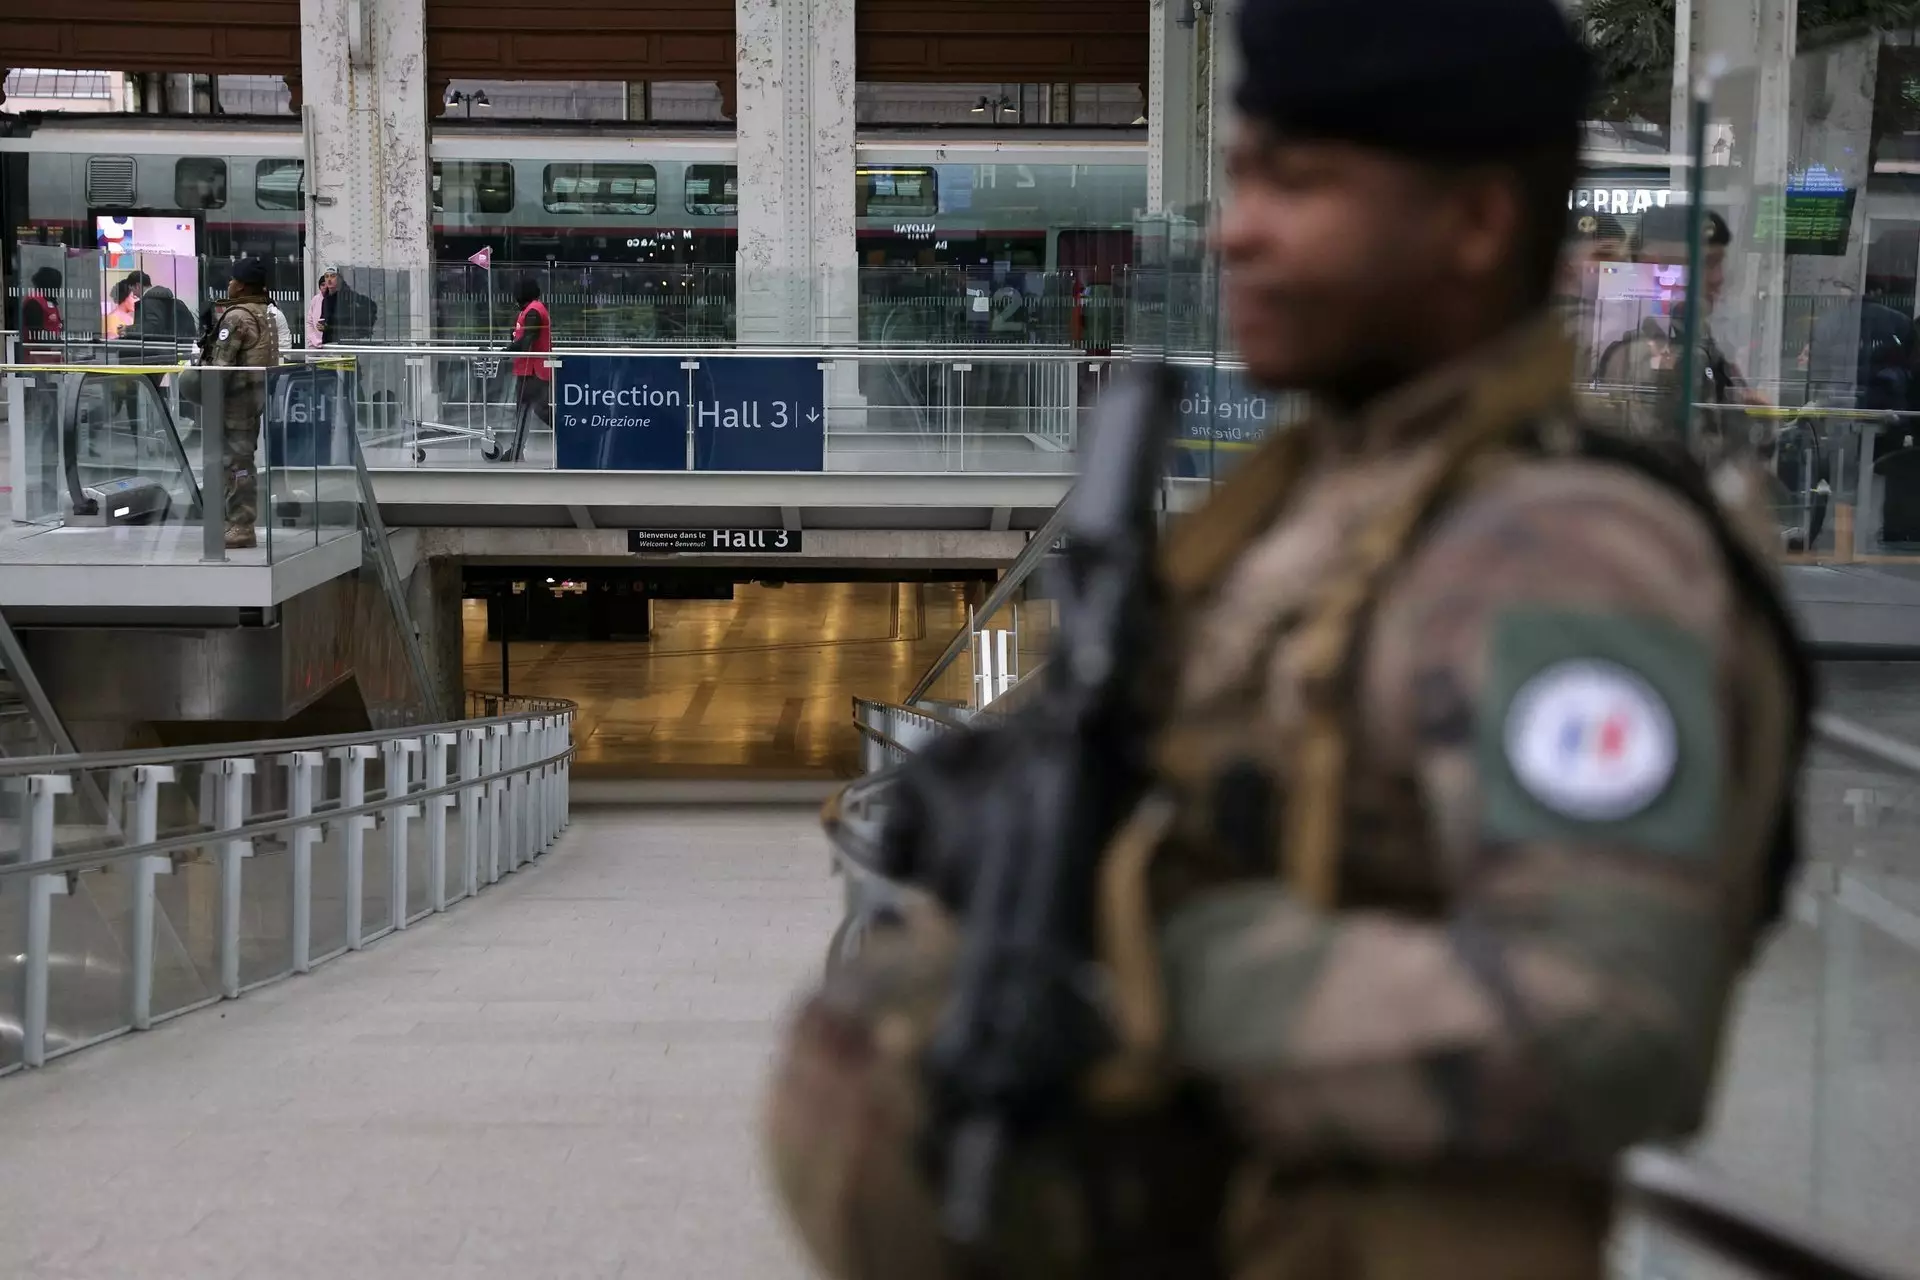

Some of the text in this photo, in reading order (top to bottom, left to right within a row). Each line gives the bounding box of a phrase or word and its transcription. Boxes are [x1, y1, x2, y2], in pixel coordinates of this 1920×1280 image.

[563, 383, 681, 407] Direction
[563, 415, 651, 427] To Direzione
[698, 401, 789, 428] Hall 3
[713, 529, 789, 547] Hall 3
